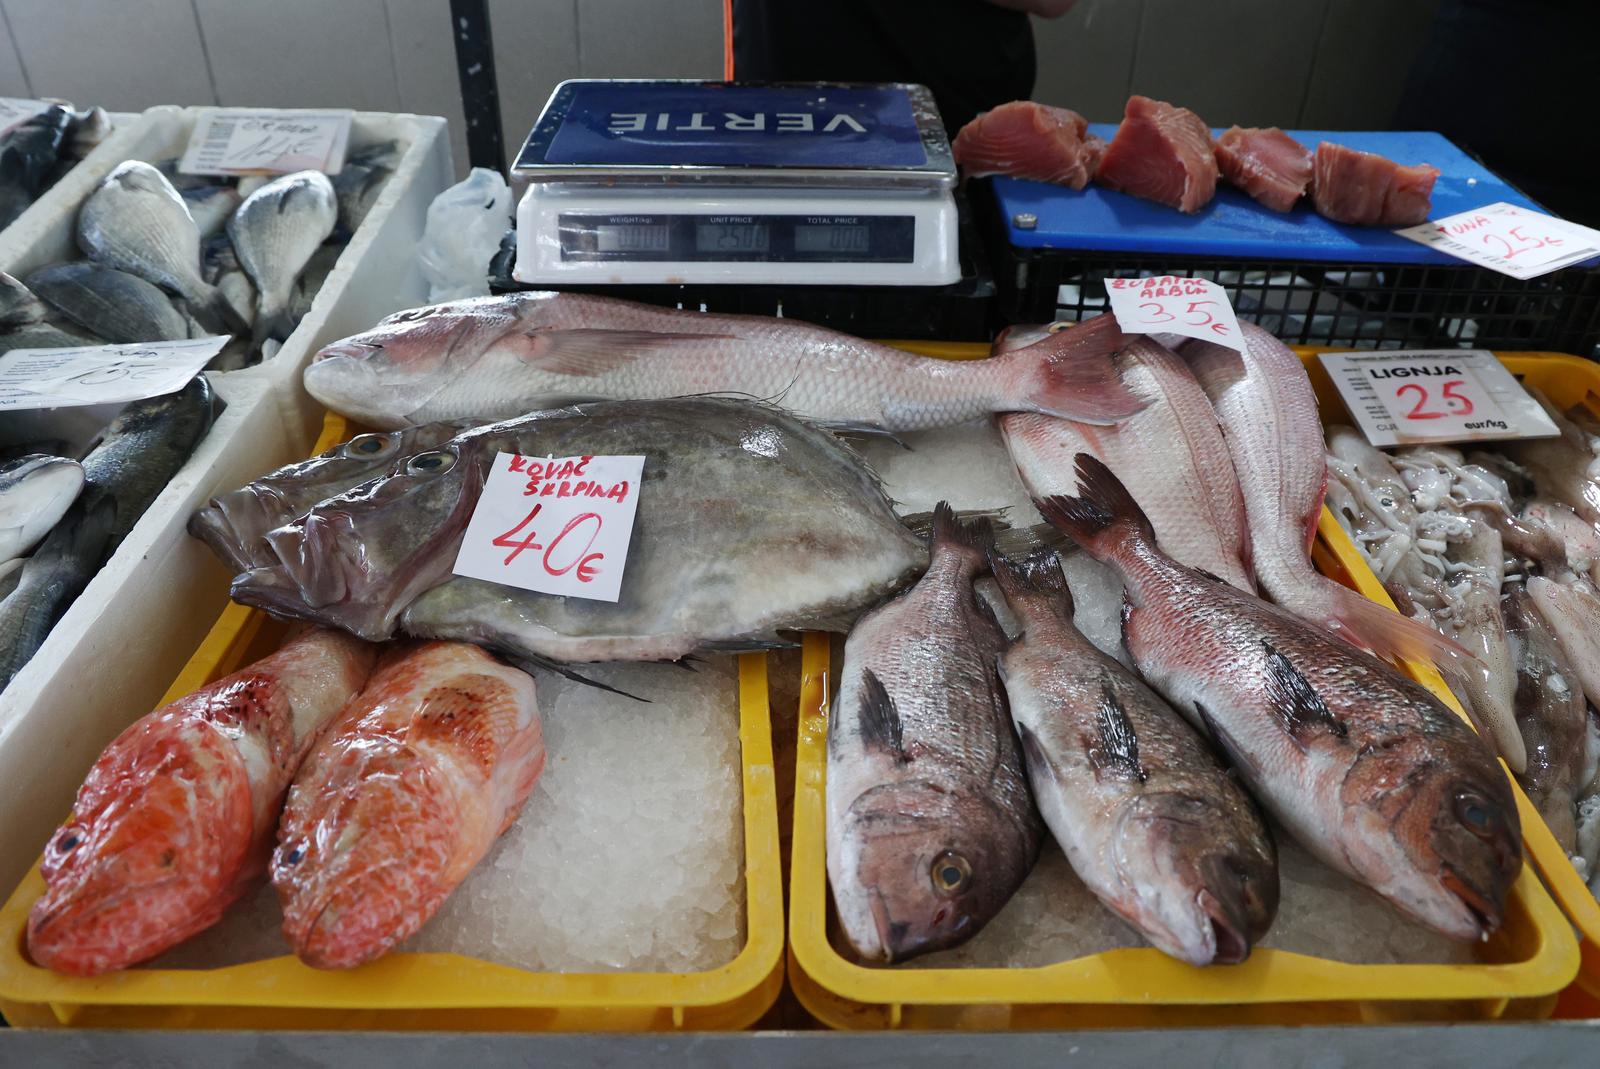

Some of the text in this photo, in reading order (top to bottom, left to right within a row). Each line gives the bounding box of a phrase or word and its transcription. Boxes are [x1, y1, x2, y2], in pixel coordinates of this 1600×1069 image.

[608, 113, 867, 132] VERTIE
[710, 216, 728, 224] UNIT
[834, 217, 858, 225] PRICE
[1436, 215, 1491, 237] TUNA
[1369, 365, 1463, 380] LIGNJA
[1464, 419, 1508, 430] eur/kg
[492, 503, 604, 583] 40€
